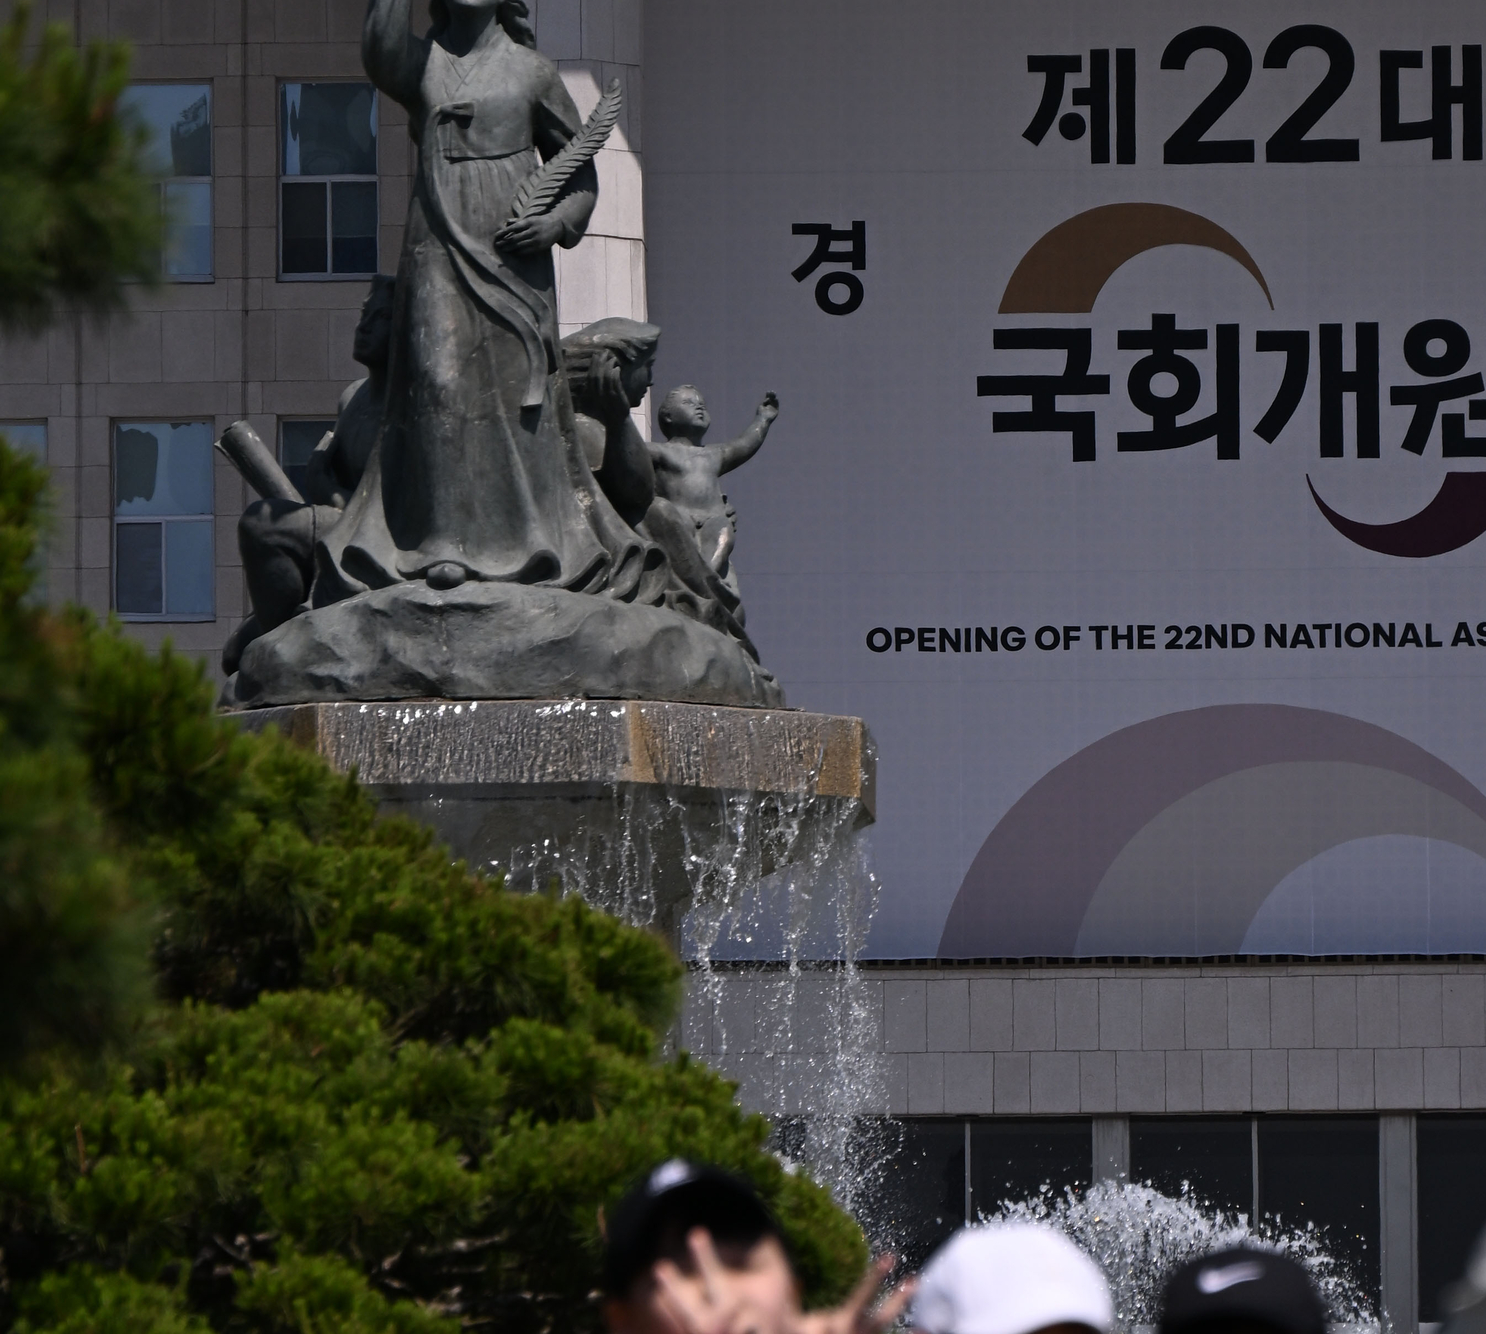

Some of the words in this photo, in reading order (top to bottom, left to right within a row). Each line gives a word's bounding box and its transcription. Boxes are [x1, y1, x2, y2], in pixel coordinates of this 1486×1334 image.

[1022, 25, 1483, 165] 제22대
[791, 221, 867, 315] 경
[865, 625, 1027, 654] OPENING
[1034, 625, 1082, 651] OF
[1088, 624, 1156, 651] THE
[1163, 623, 1256, 650] 22ND
[1264, 622, 1443, 649] NATIONAL
